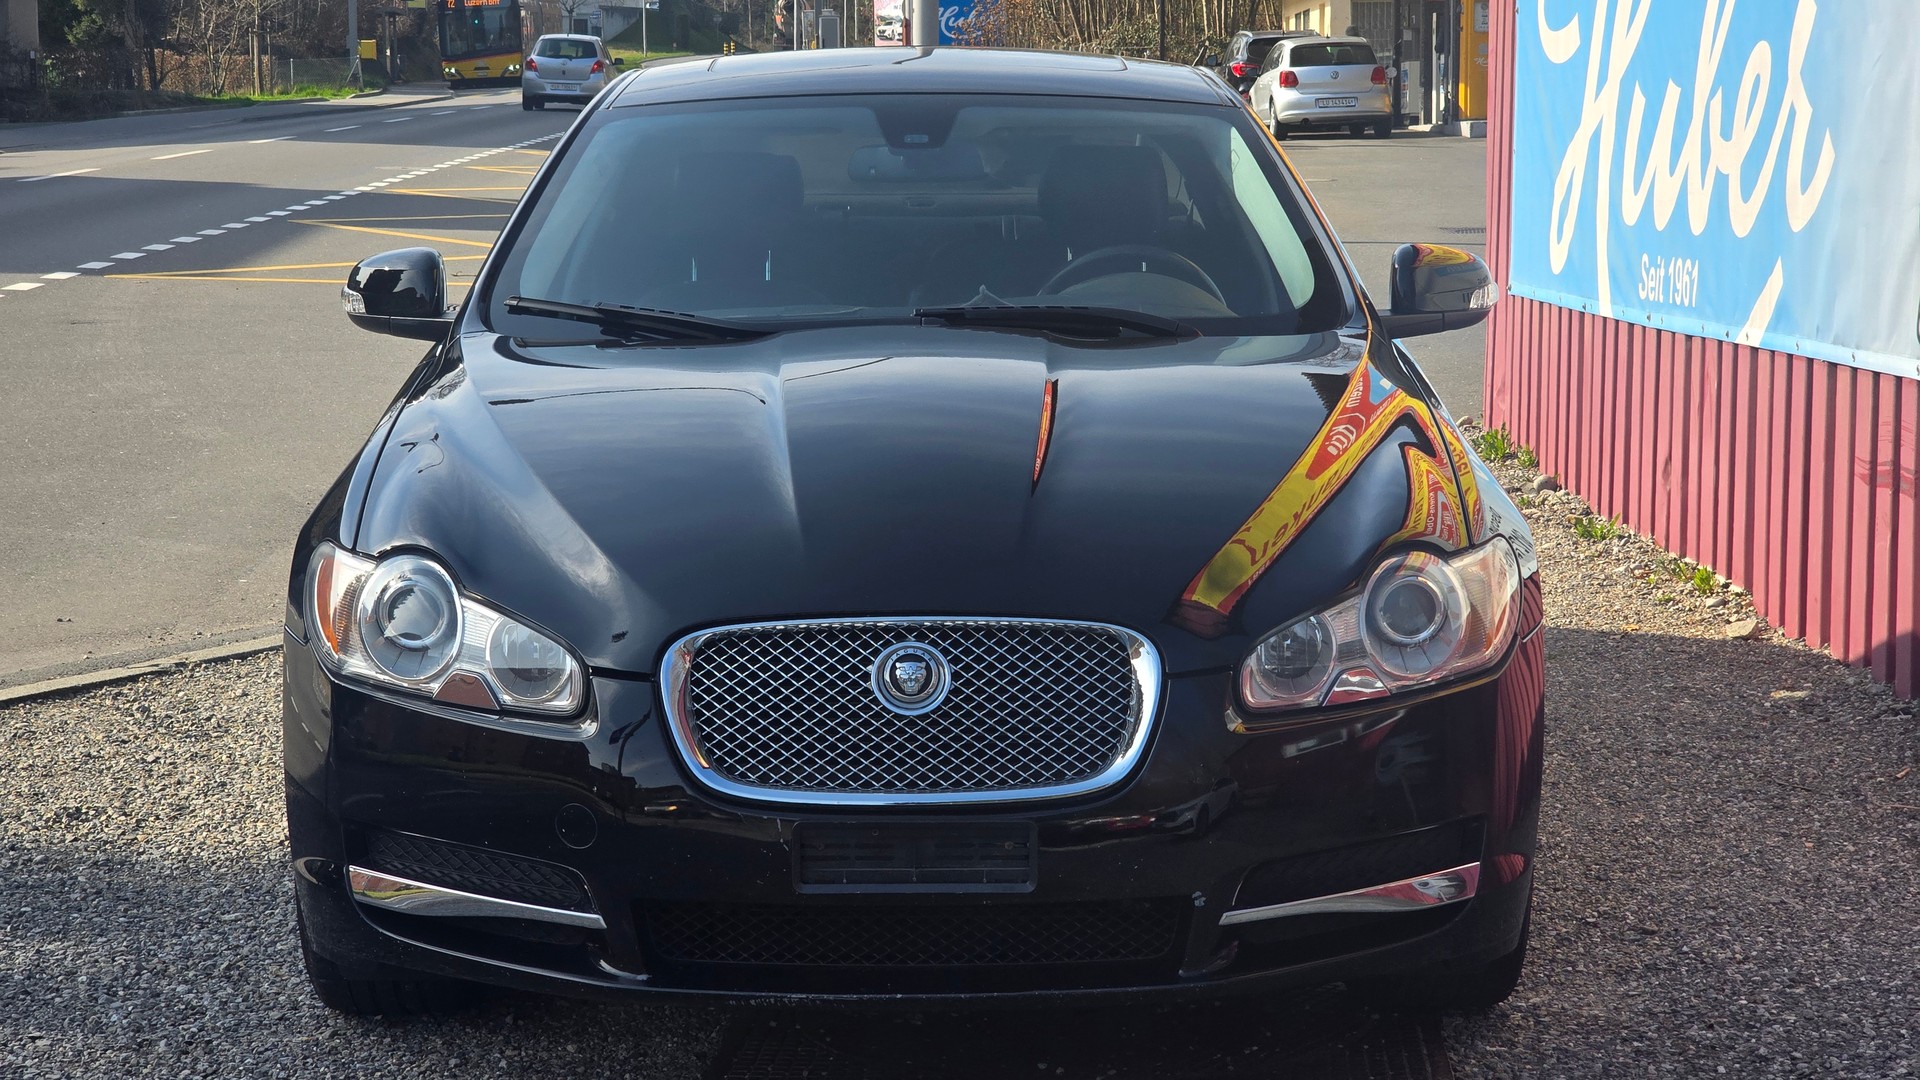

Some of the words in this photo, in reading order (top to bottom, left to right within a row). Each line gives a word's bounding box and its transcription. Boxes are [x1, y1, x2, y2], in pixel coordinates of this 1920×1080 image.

[1638, 253, 1664, 303] Seit
[1668, 256, 1698, 307] 1961
[890, 649, 933, 662] JAGUAR
